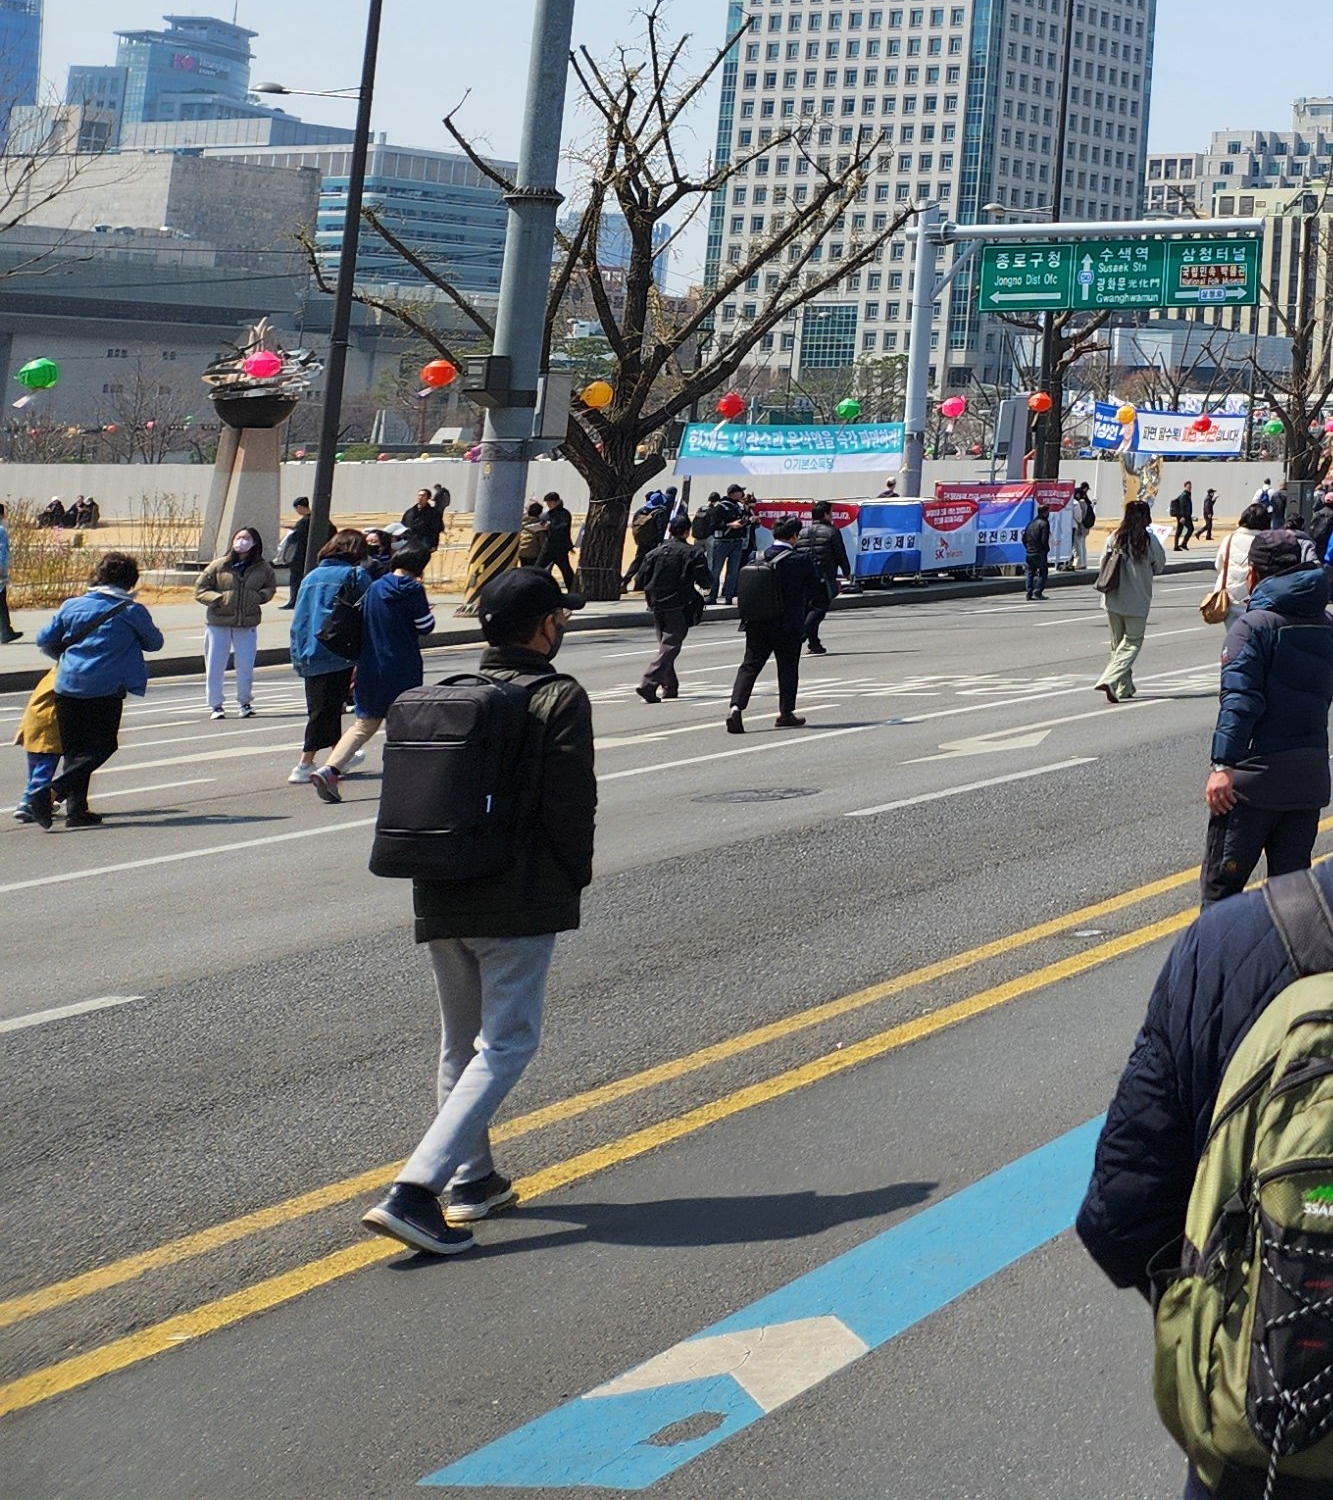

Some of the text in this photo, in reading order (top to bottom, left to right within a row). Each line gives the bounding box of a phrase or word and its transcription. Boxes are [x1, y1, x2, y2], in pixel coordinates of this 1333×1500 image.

[995, 252, 1061, 269] 종로구청
[1100, 247, 1149, 262] 수색역
[1181, 247, 1246, 262] 삼청터널
[1098, 262, 1147, 273] Susaek Stn
[994, 273, 1058, 288] Jongno Dist Ofc
[1097, 277, 1126, 291] 광화문
[1096, 293, 1159, 304] Gwanghwamun
[836, 430, 859, 449] 즉각
